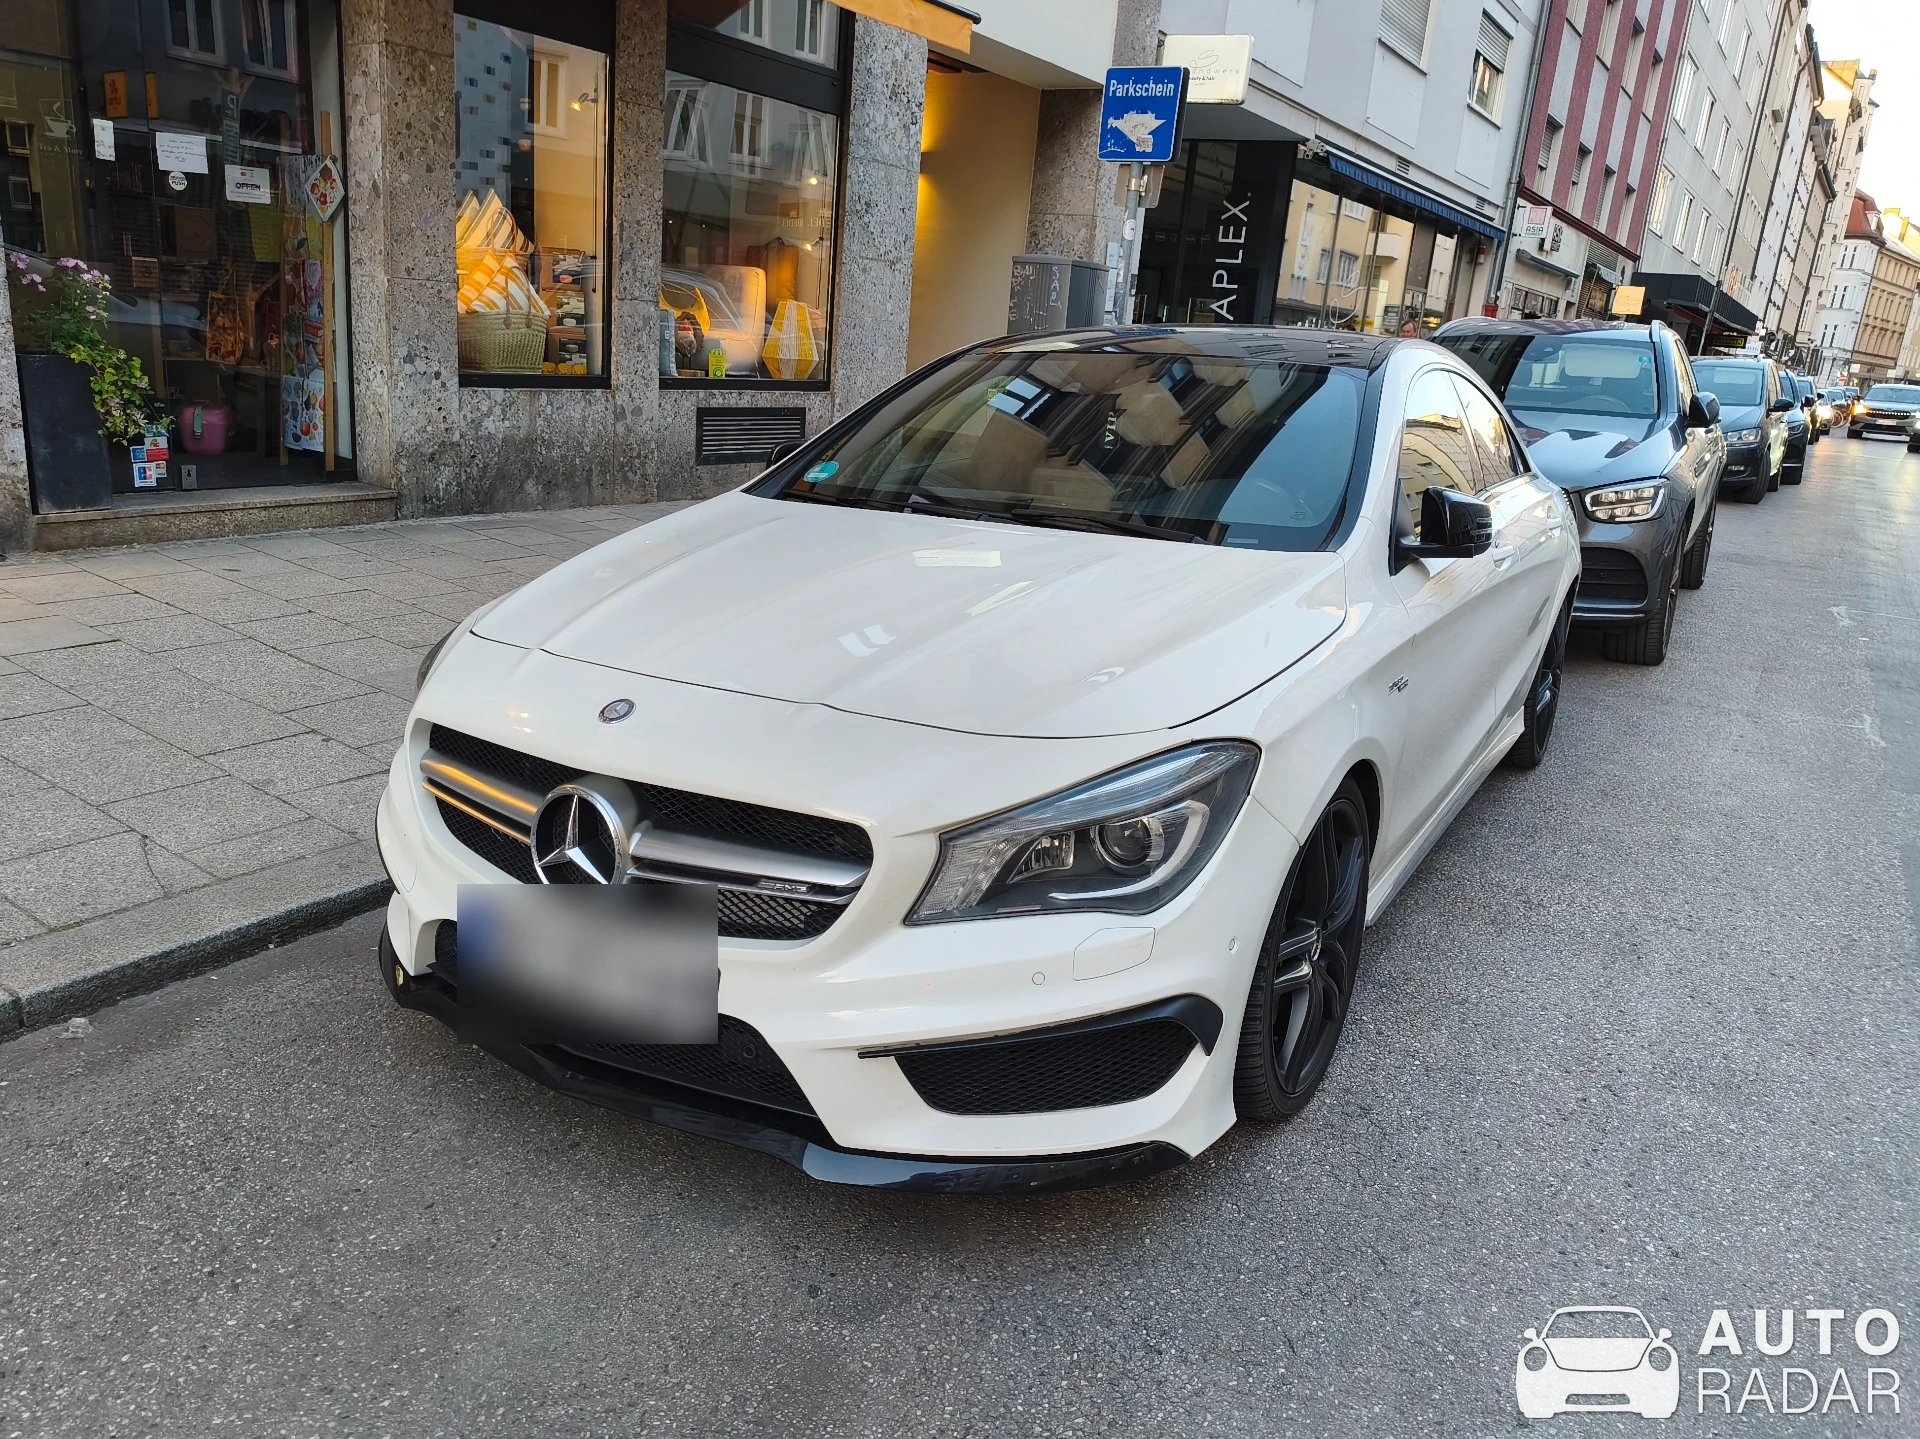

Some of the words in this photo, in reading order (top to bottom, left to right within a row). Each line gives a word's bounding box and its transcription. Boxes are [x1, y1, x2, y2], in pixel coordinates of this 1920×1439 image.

[1109, 76, 1175, 97] Parkschein
[38, 143, 52, 151] Tea
[63, 146, 84, 155] More
[235, 182, 261, 191] OFFEN
[1526, 226, 1544, 234] ASIA
